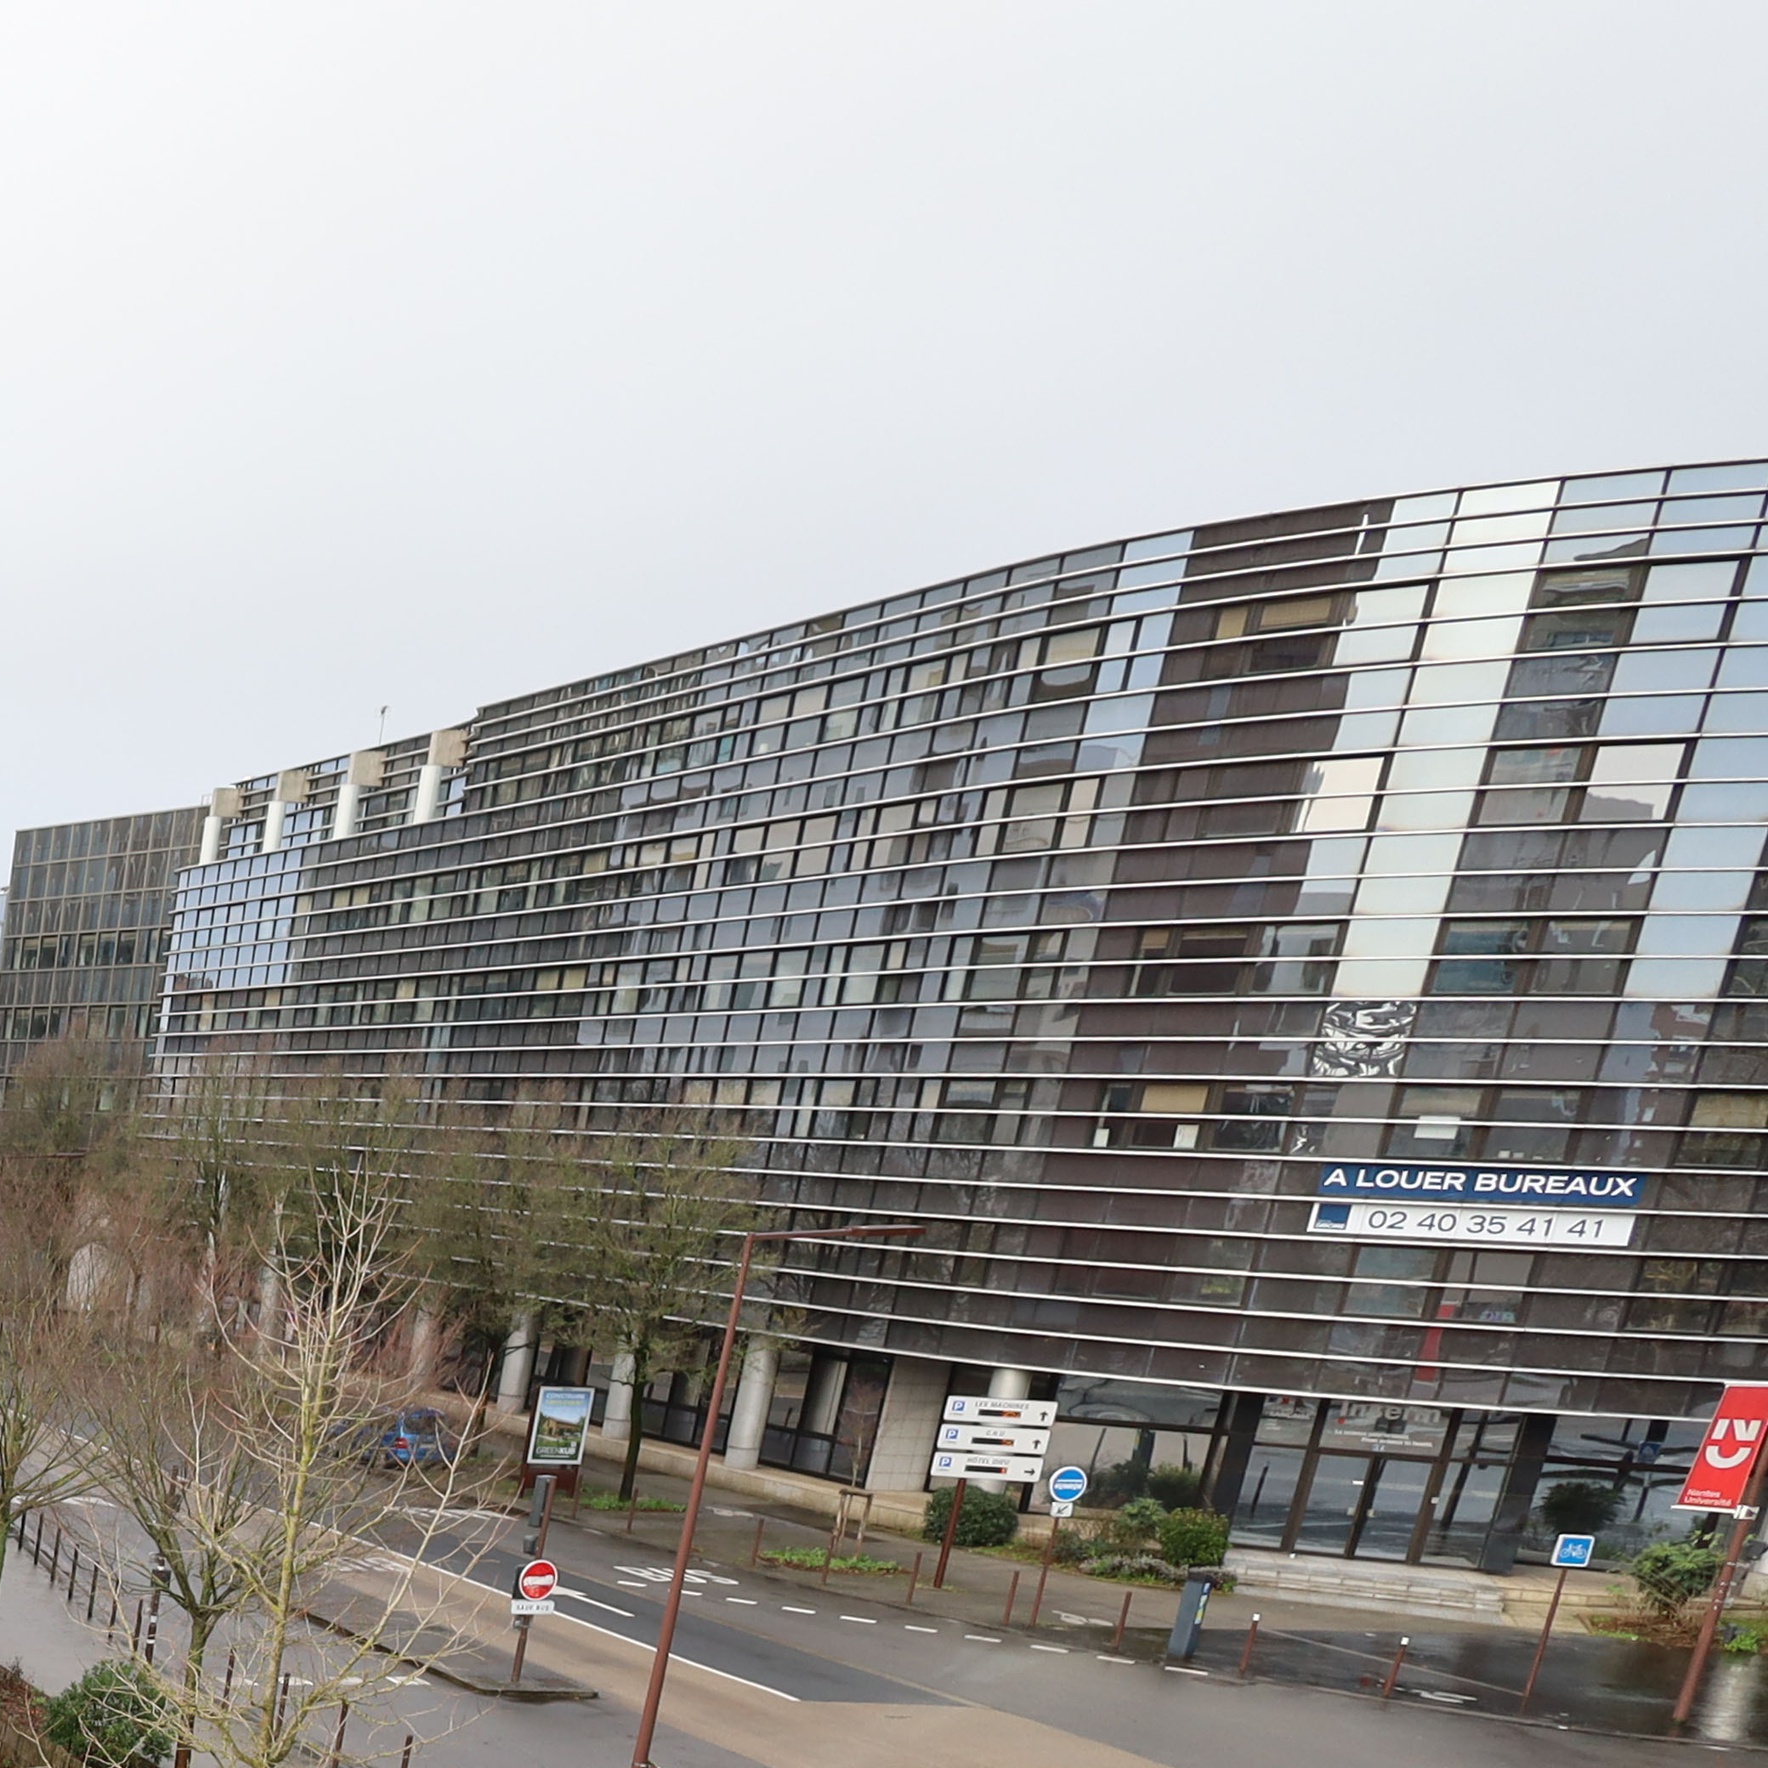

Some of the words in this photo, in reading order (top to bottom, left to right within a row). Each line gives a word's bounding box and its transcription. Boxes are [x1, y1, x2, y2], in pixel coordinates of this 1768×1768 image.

[1323, 1168, 1347, 1187] A
[1355, 1168, 1466, 1191] LOUER
[1474, 1173, 1637, 1197] BUREAUX
[1368, 1210, 1408, 1230] 02
[1417, 1213, 1457, 1232] 40
[1466, 1215, 1507, 1235] 35
[1516, 1217, 1554, 1237] 41
[1567, 1219, 1604, 1239] 41
[1684, 1495, 1732, 1507] Université
